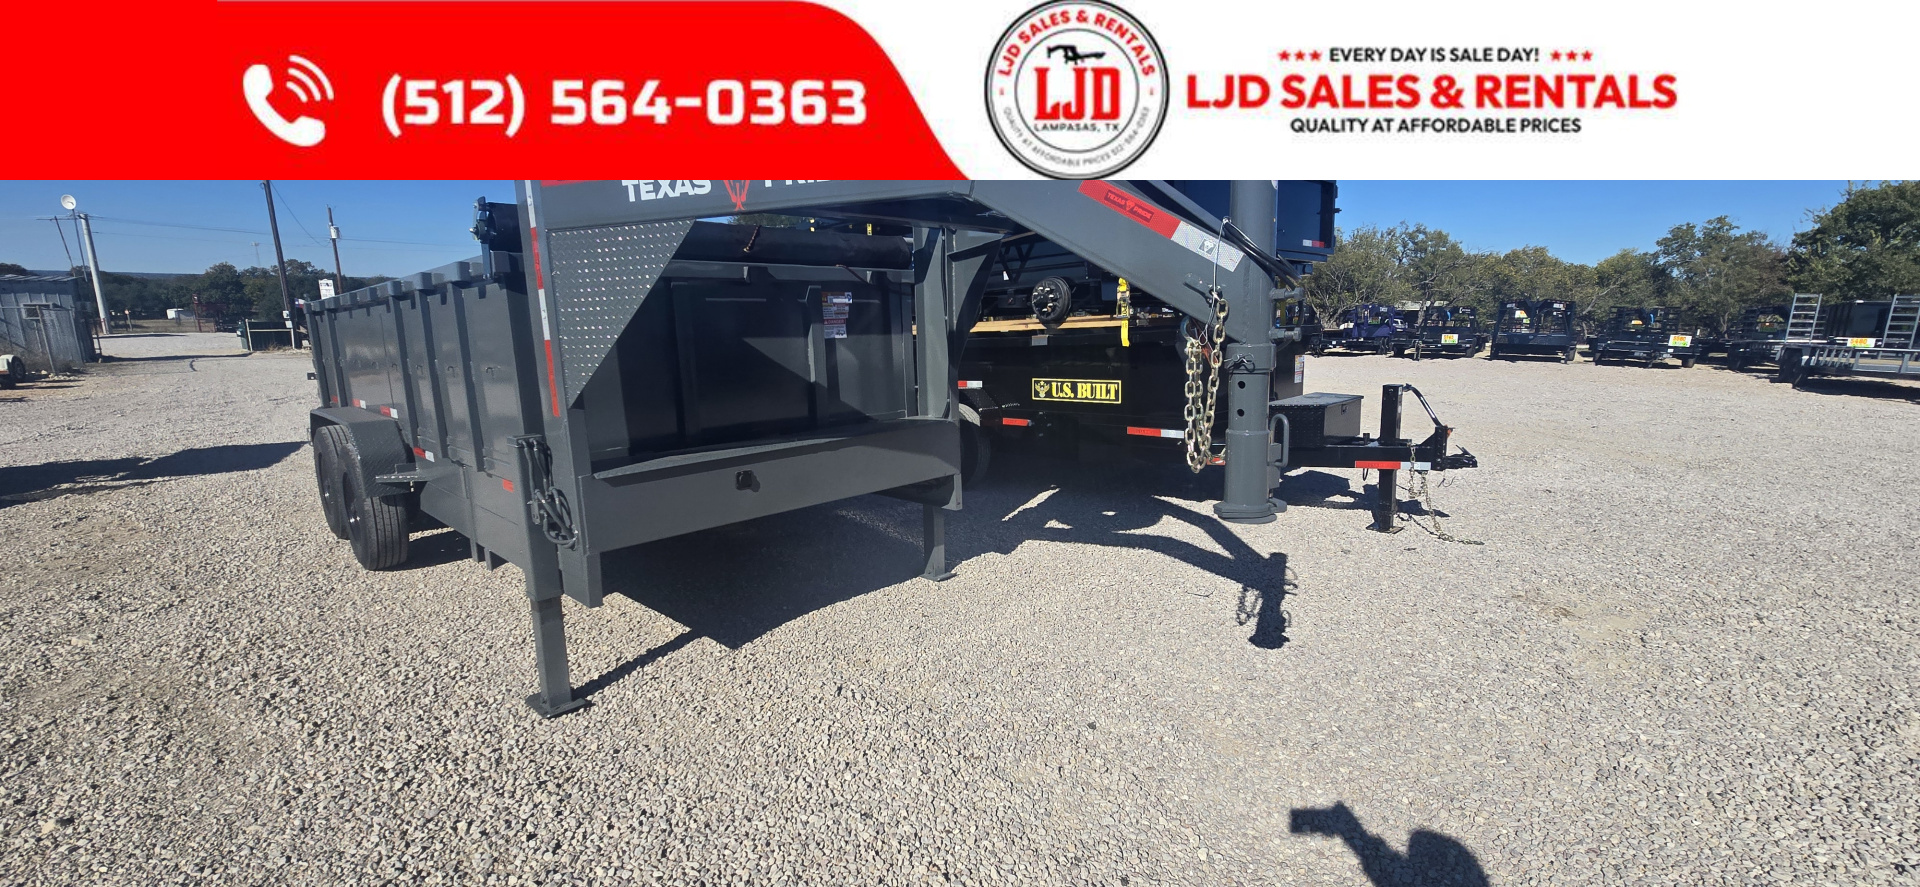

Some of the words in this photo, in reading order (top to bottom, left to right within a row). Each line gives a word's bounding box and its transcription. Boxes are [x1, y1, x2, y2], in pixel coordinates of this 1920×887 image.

[621, 180, 712, 202] TEXAS
[1107, 192, 1126, 205] TEXAS
[1133, 206, 1152, 219] PRIDE
[1051, 382, 1075, 398] U.S.
[1077, 382, 1118, 400] BUILT
